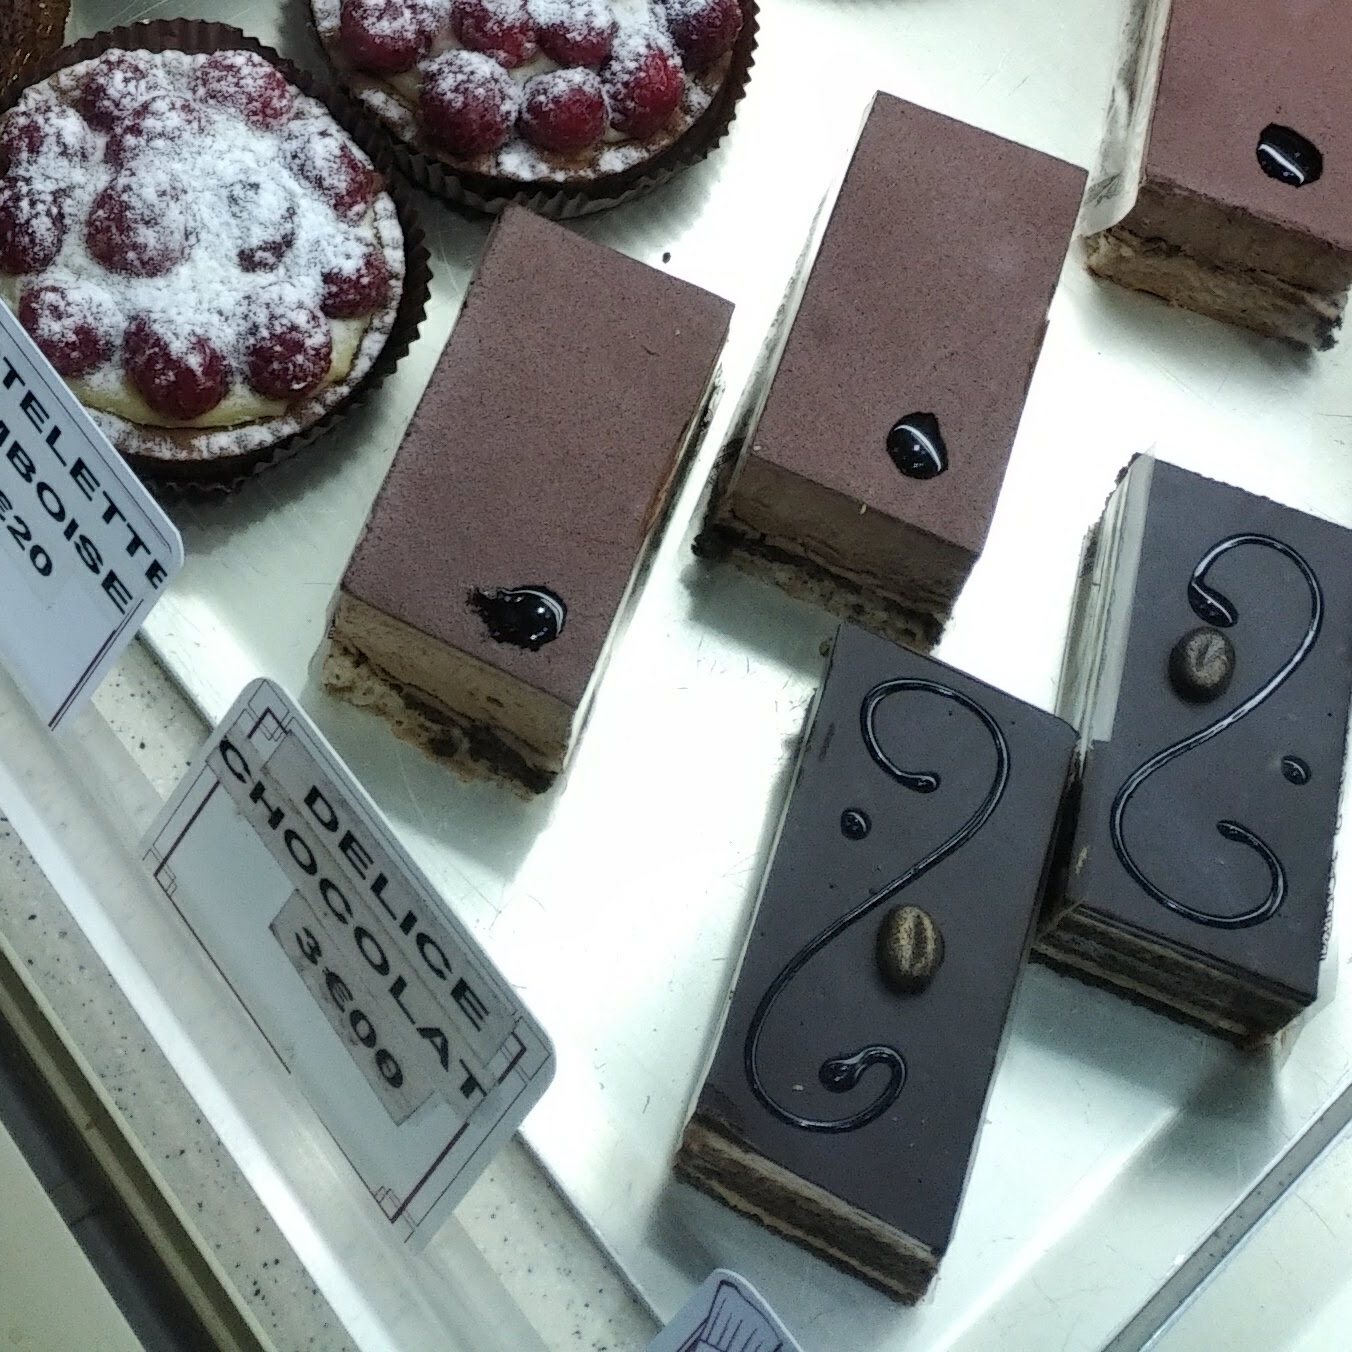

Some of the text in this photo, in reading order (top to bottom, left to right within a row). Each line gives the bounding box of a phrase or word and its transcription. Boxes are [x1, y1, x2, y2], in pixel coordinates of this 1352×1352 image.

[219, 736, 487, 1100] CHOCOLAT
[294, 925, 404, 1089] 3€00
[303, 784, 491, 1033] DELICE
